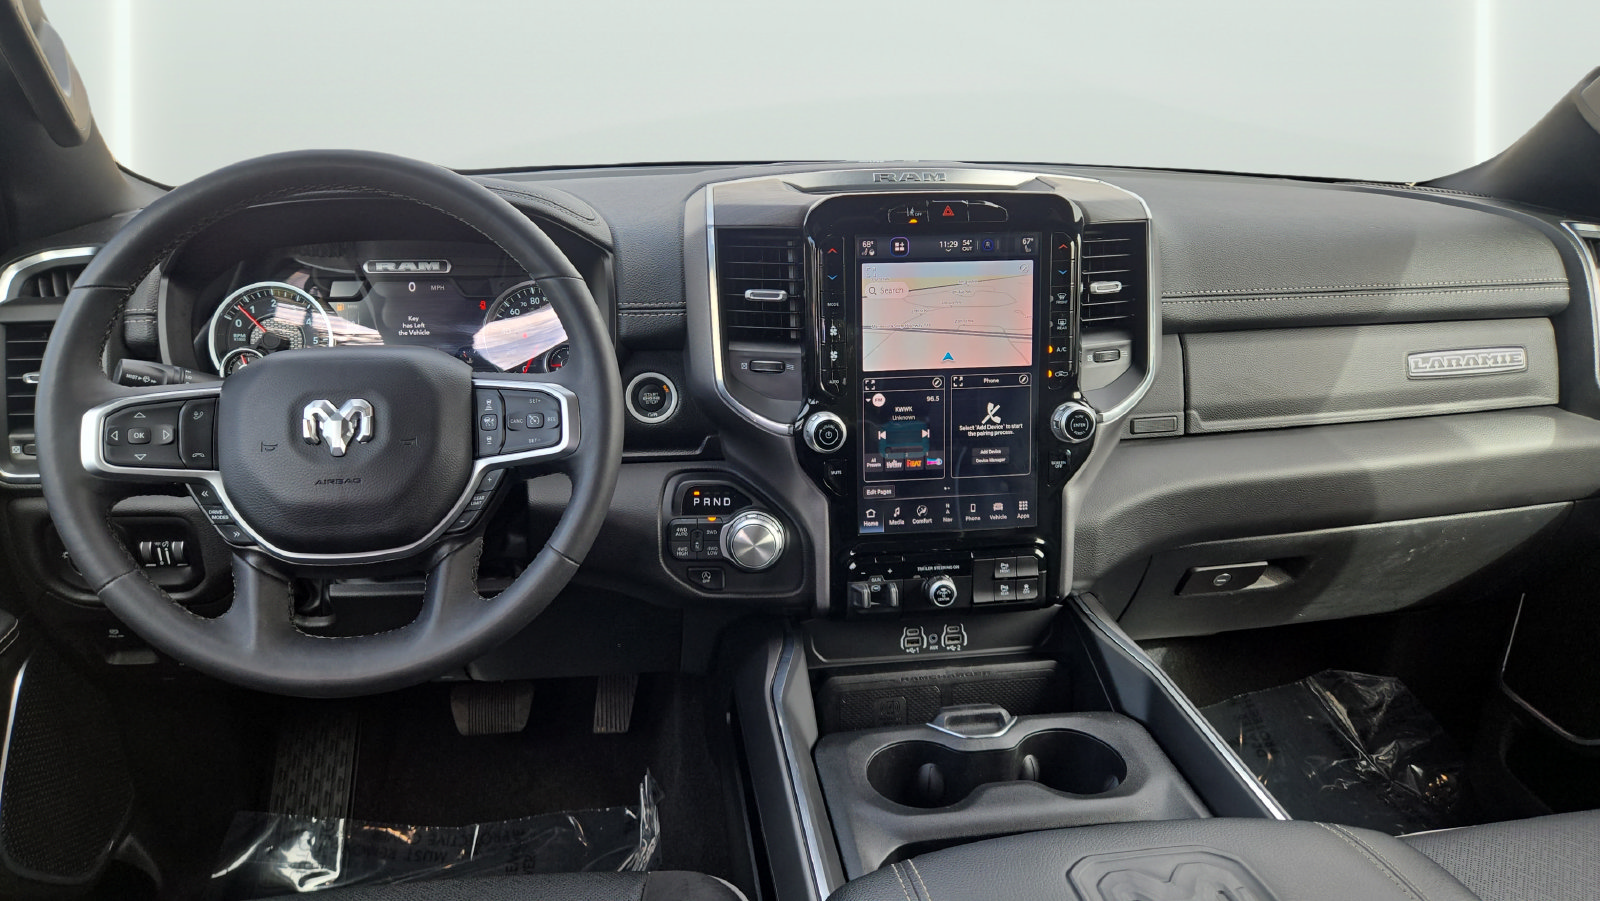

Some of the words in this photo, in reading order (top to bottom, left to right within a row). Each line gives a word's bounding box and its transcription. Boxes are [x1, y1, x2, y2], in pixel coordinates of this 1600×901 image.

[873, 172, 946, 182] RAM
[939, 241, 959, 249] 11:29
[375, 262, 440, 272] RAM
[408, 281, 416, 292] 0
[880, 286, 904, 294] Search
[270, 299, 277, 308] 2
[530, 297, 540, 305] 80
[249, 305, 255, 314] 1
[235, 318, 242, 327] 0
[305, 318, 311, 326] 4
[313, 336, 319, 344] 5
[1411, 352, 1523, 371] LARAMIE
[314, 478, 361, 486] AIRBAG
[877, 489, 892, 497] Pages
[912, 517, 933, 525] Comfort
